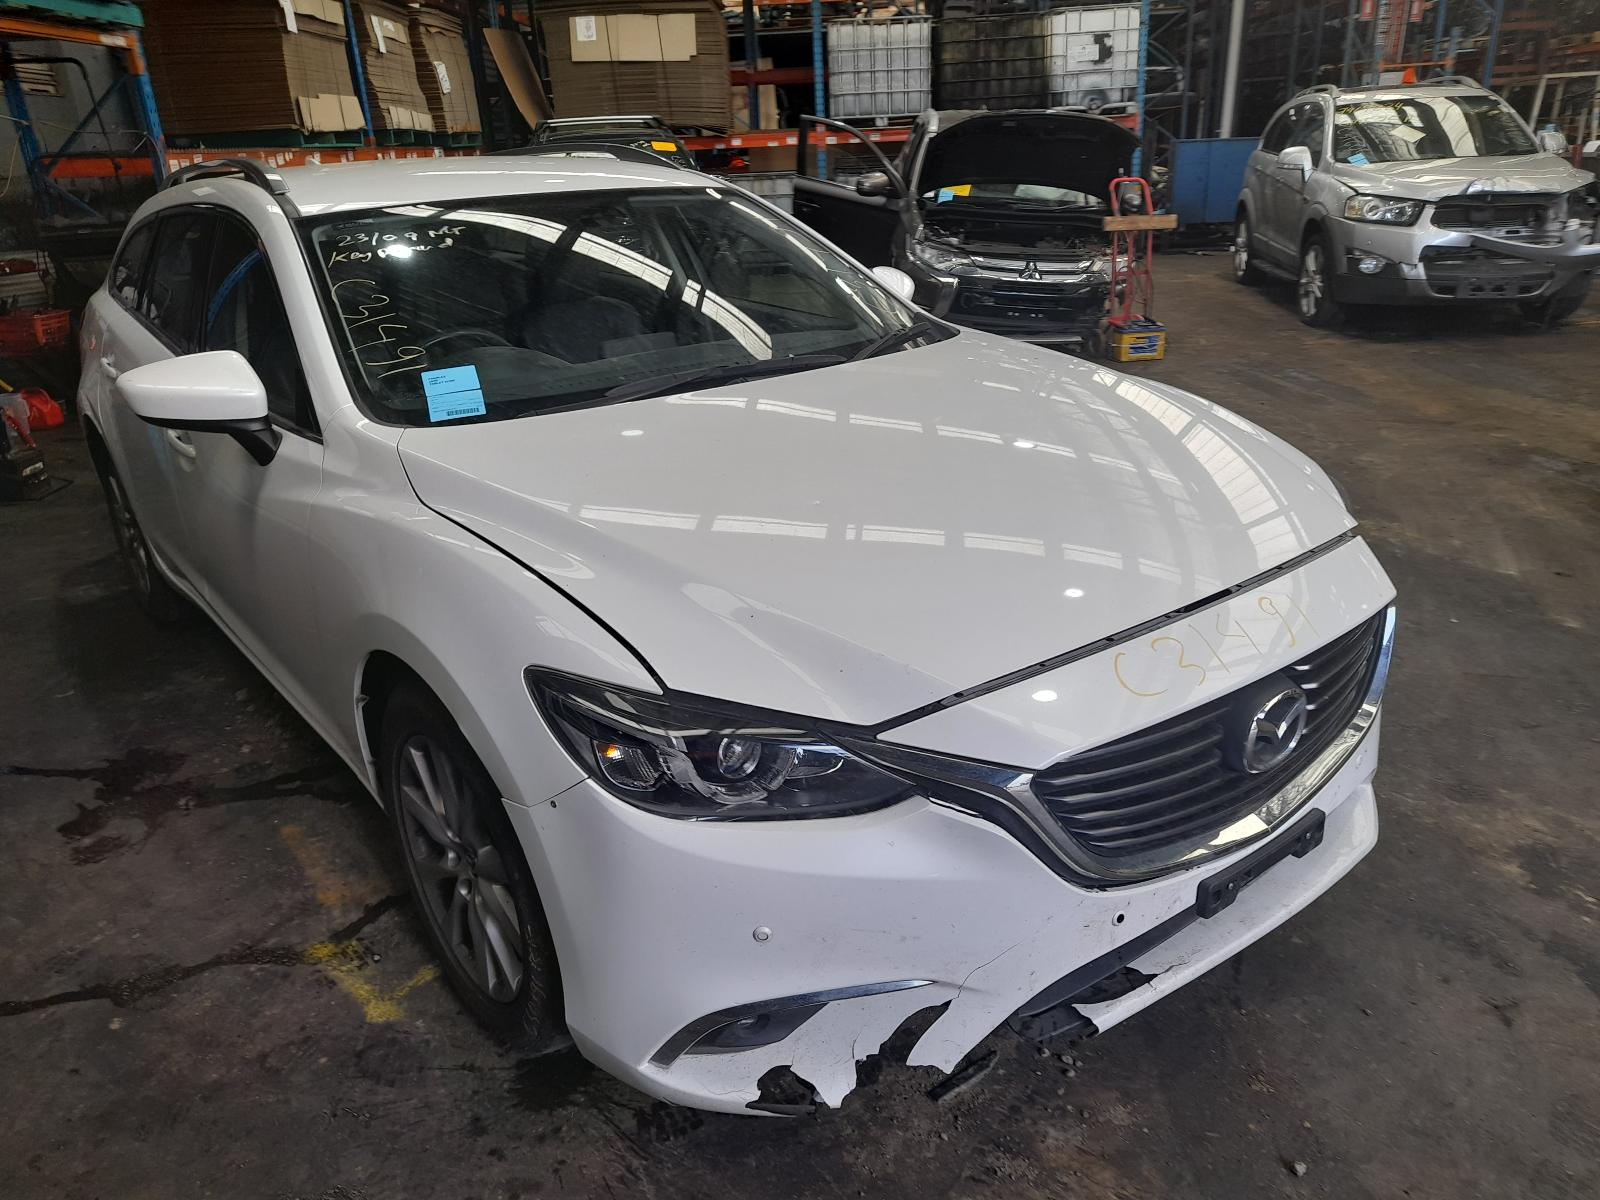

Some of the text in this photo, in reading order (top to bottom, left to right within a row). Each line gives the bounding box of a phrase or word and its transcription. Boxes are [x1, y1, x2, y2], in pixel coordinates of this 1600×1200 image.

[327, 250, 372, 269] Key
[331, 279, 428, 379] C31491
[1112, 594, 1321, 697] C31491
